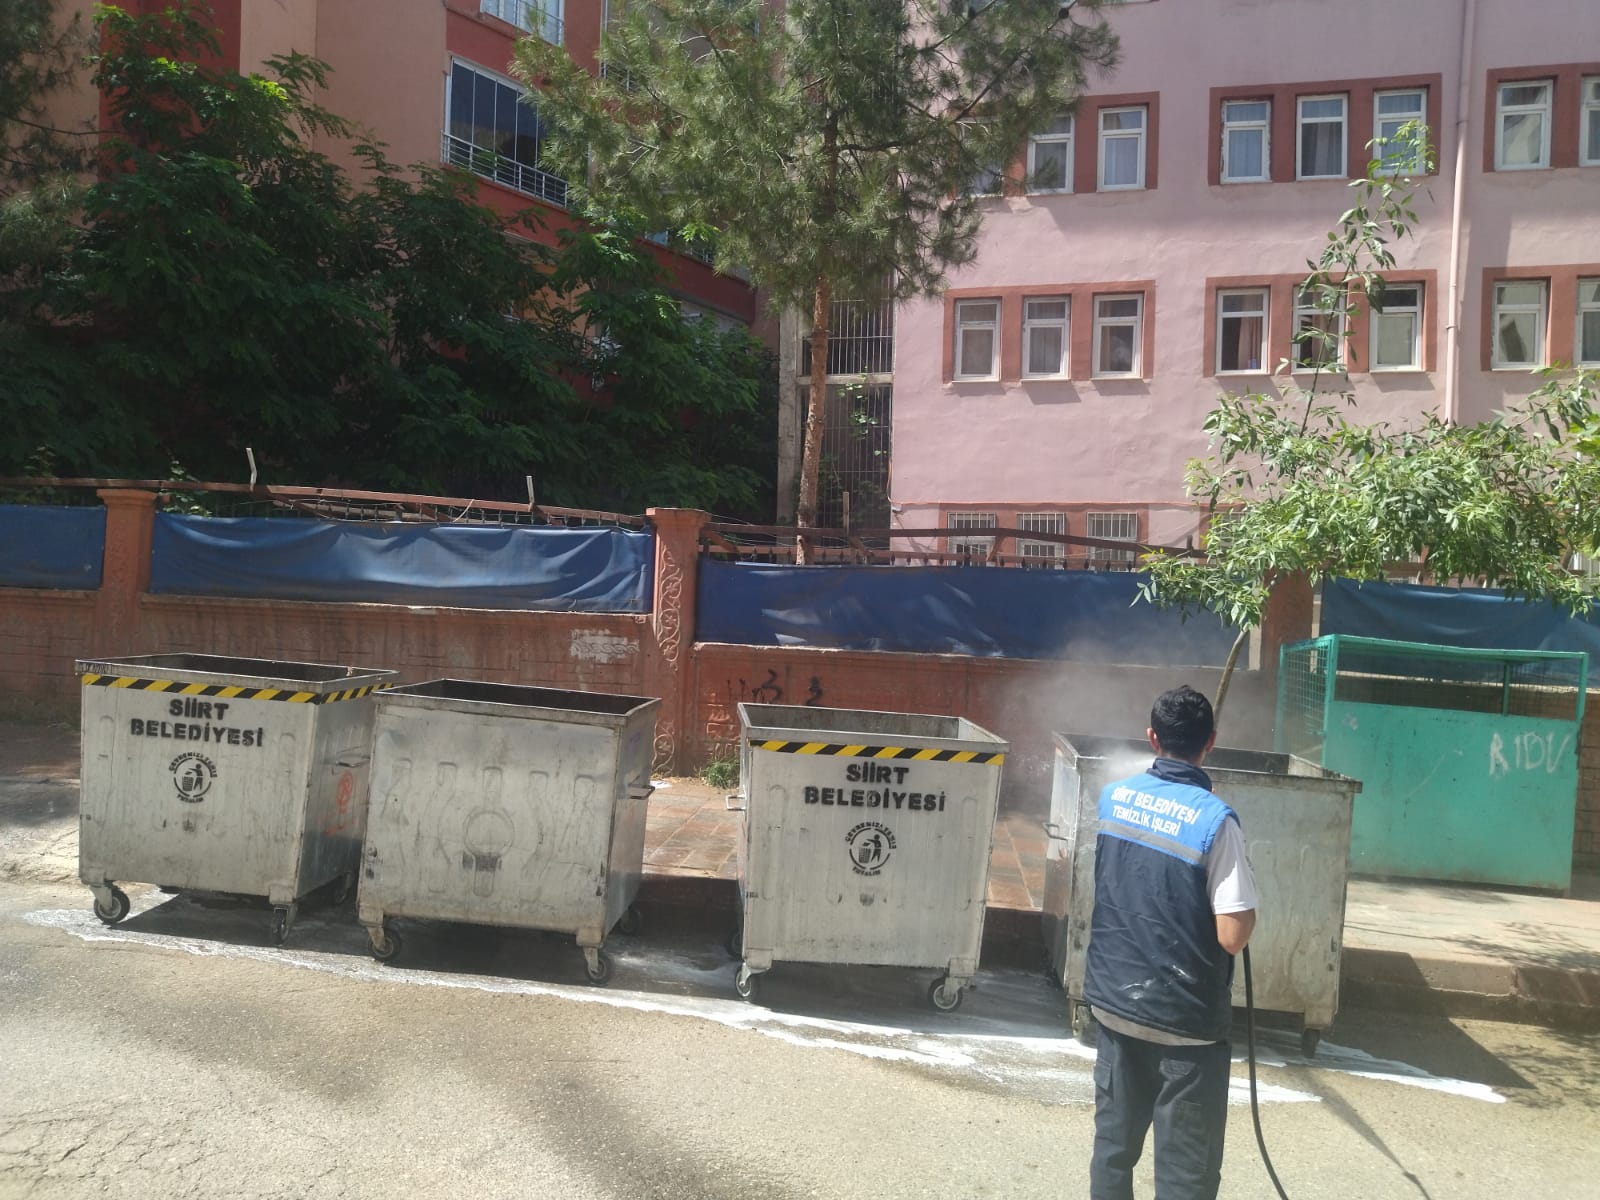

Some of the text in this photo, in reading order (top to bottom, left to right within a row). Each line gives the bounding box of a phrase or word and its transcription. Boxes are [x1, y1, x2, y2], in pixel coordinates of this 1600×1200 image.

[130, 717, 264, 747] BELEDİYESİ
[804, 785, 946, 812] BELEDİYESİ
[1134, 791, 1202, 825] BELEDİYESİ
[1112, 805, 1181, 837] TEMİZLİK İŞLERİ
